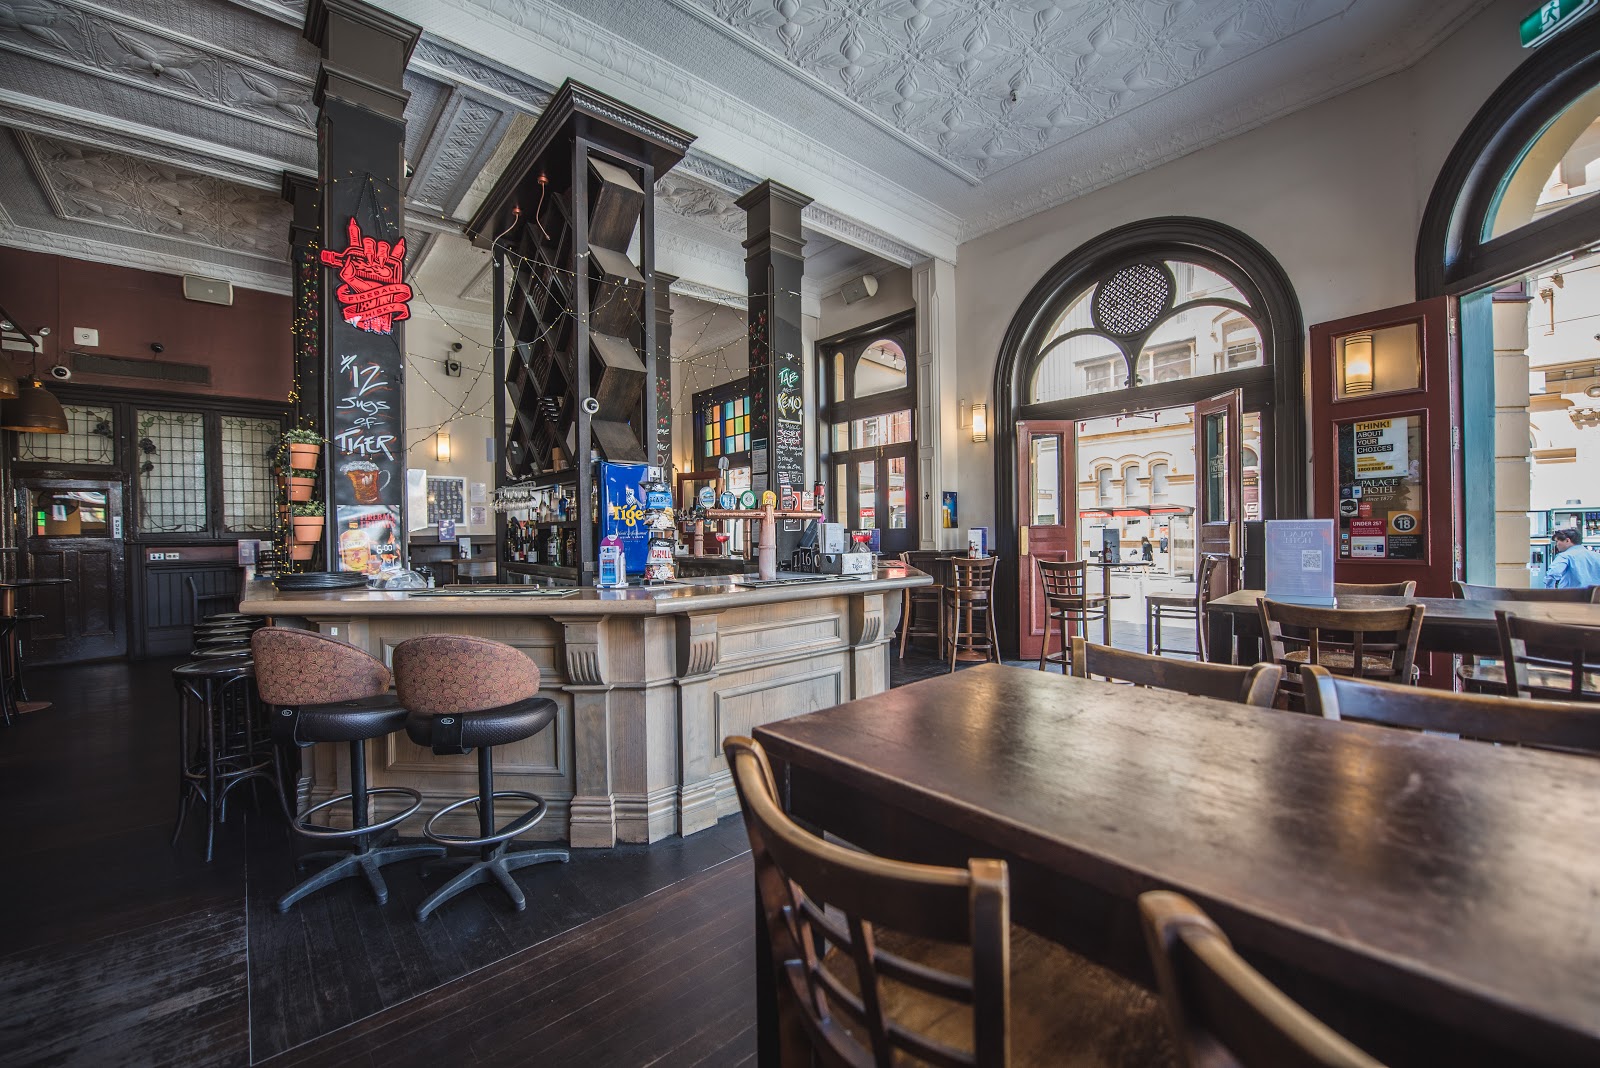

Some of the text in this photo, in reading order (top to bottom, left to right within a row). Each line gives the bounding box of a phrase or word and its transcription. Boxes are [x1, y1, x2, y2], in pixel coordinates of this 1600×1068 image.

[348, 286, 401, 302] FIREBALL
[1357, 420, 1390, 430] THINK!
[1357, 430, 1382, 438] ABOUT
[334, 427, 395, 462] TIGER
[1357, 445, 1392, 454] CHOICES
[1361, 479, 1399, 488] PALACE
[1363, 487, 1396, 495] HOTEL
[1398, 519, 1411, 529] 18
